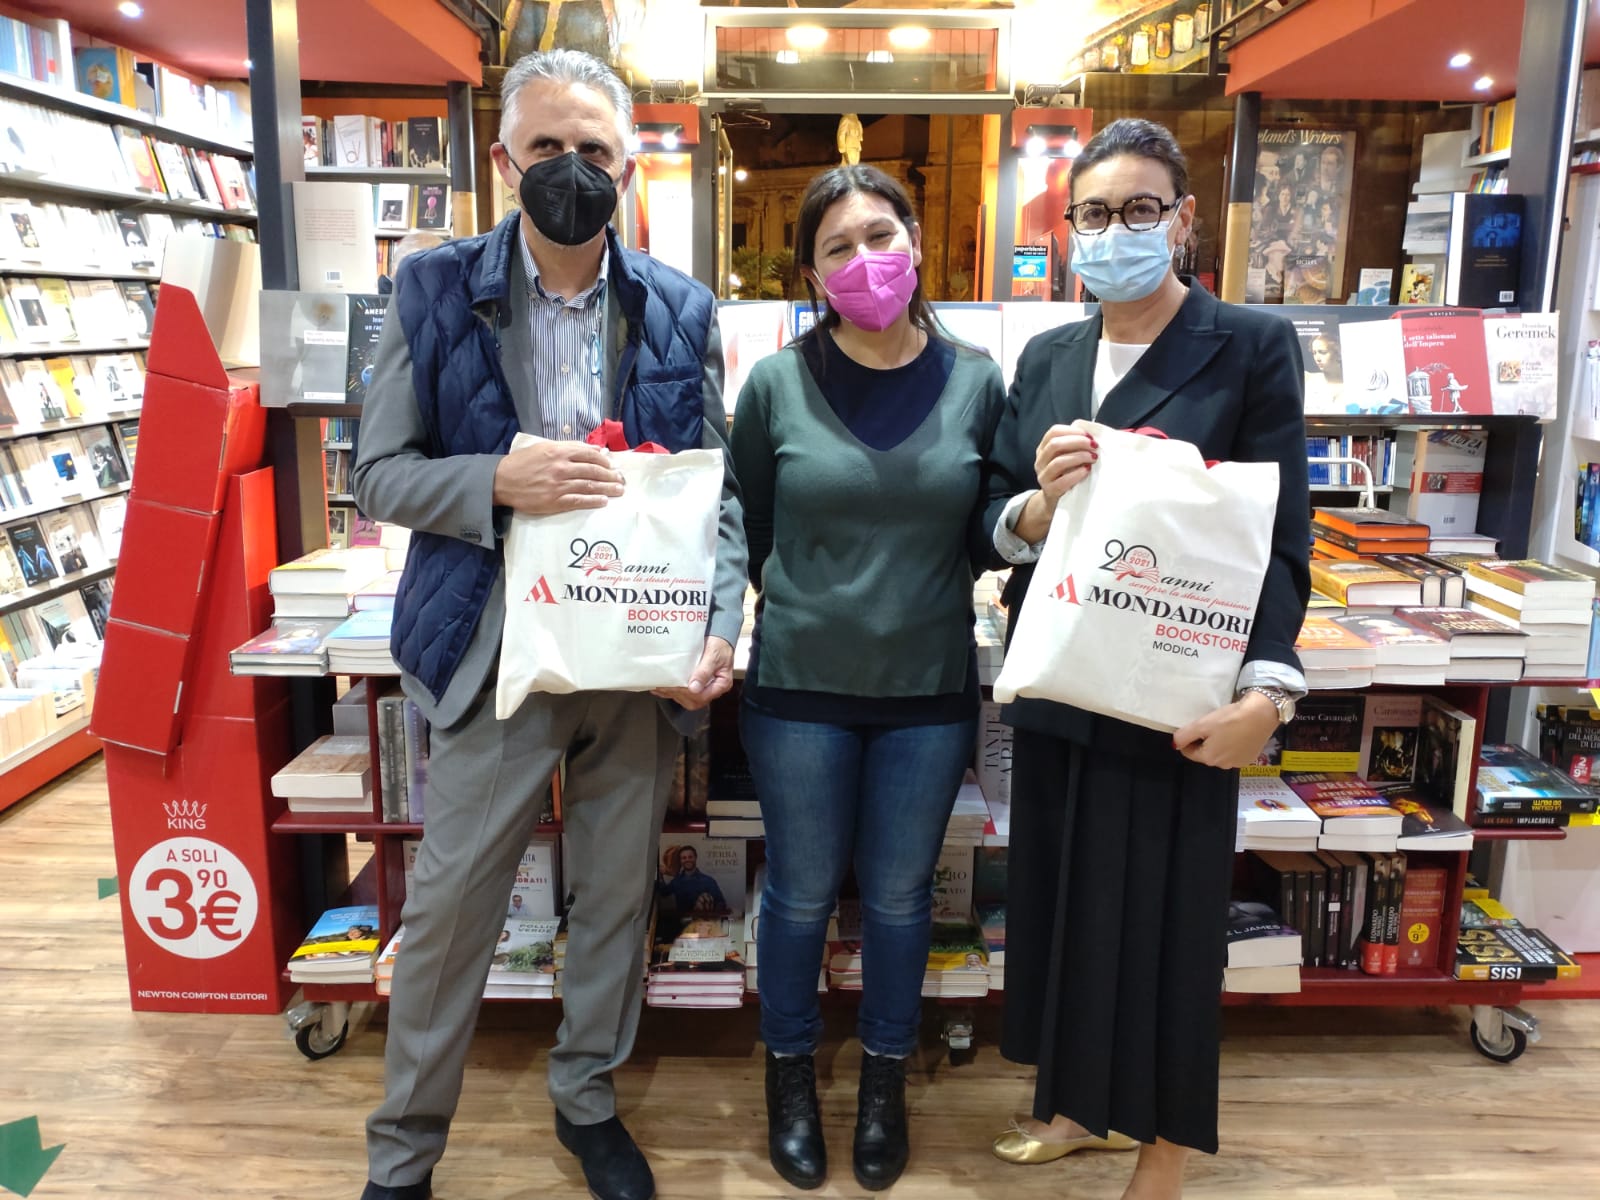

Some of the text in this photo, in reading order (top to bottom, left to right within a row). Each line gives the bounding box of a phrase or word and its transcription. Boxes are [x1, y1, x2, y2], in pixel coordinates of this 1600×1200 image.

[1300, 129, 1342, 145] Writers
[1496, 325, 1556, 339] Geremek
[594, 552, 613, 560] 2021
[1129, 556, 1150, 566] 2021
[624, 562, 670, 574] anni
[1160, 576, 1215, 592] anni
[562, 584, 706, 606] MONDADORI
[628, 609, 708, 622] BOOKSTORE
[1085, 585, 1253, 636] MONDADORI
[628, 625, 670, 634] MODICA
[1155, 624, 1249, 653] BOOKSTORE
[1152, 640, 1199, 658] MODICA
[1294, 712, 1358, 722] Steve Cavanagh
[1578, 756, 1587, 766] 2
[1290, 774, 1328, 784] JOHN
[1316, 782, 1368, 790] GREEN
[167, 818, 206, 830] KING
[166, 849, 218, 863] A SOLI
[145, 868, 242, 942] 3 90 €
[1244, 924, 1280, 932] JAMES
[138, 990, 268, 1000] NEWTON COMPTON EDITORI
